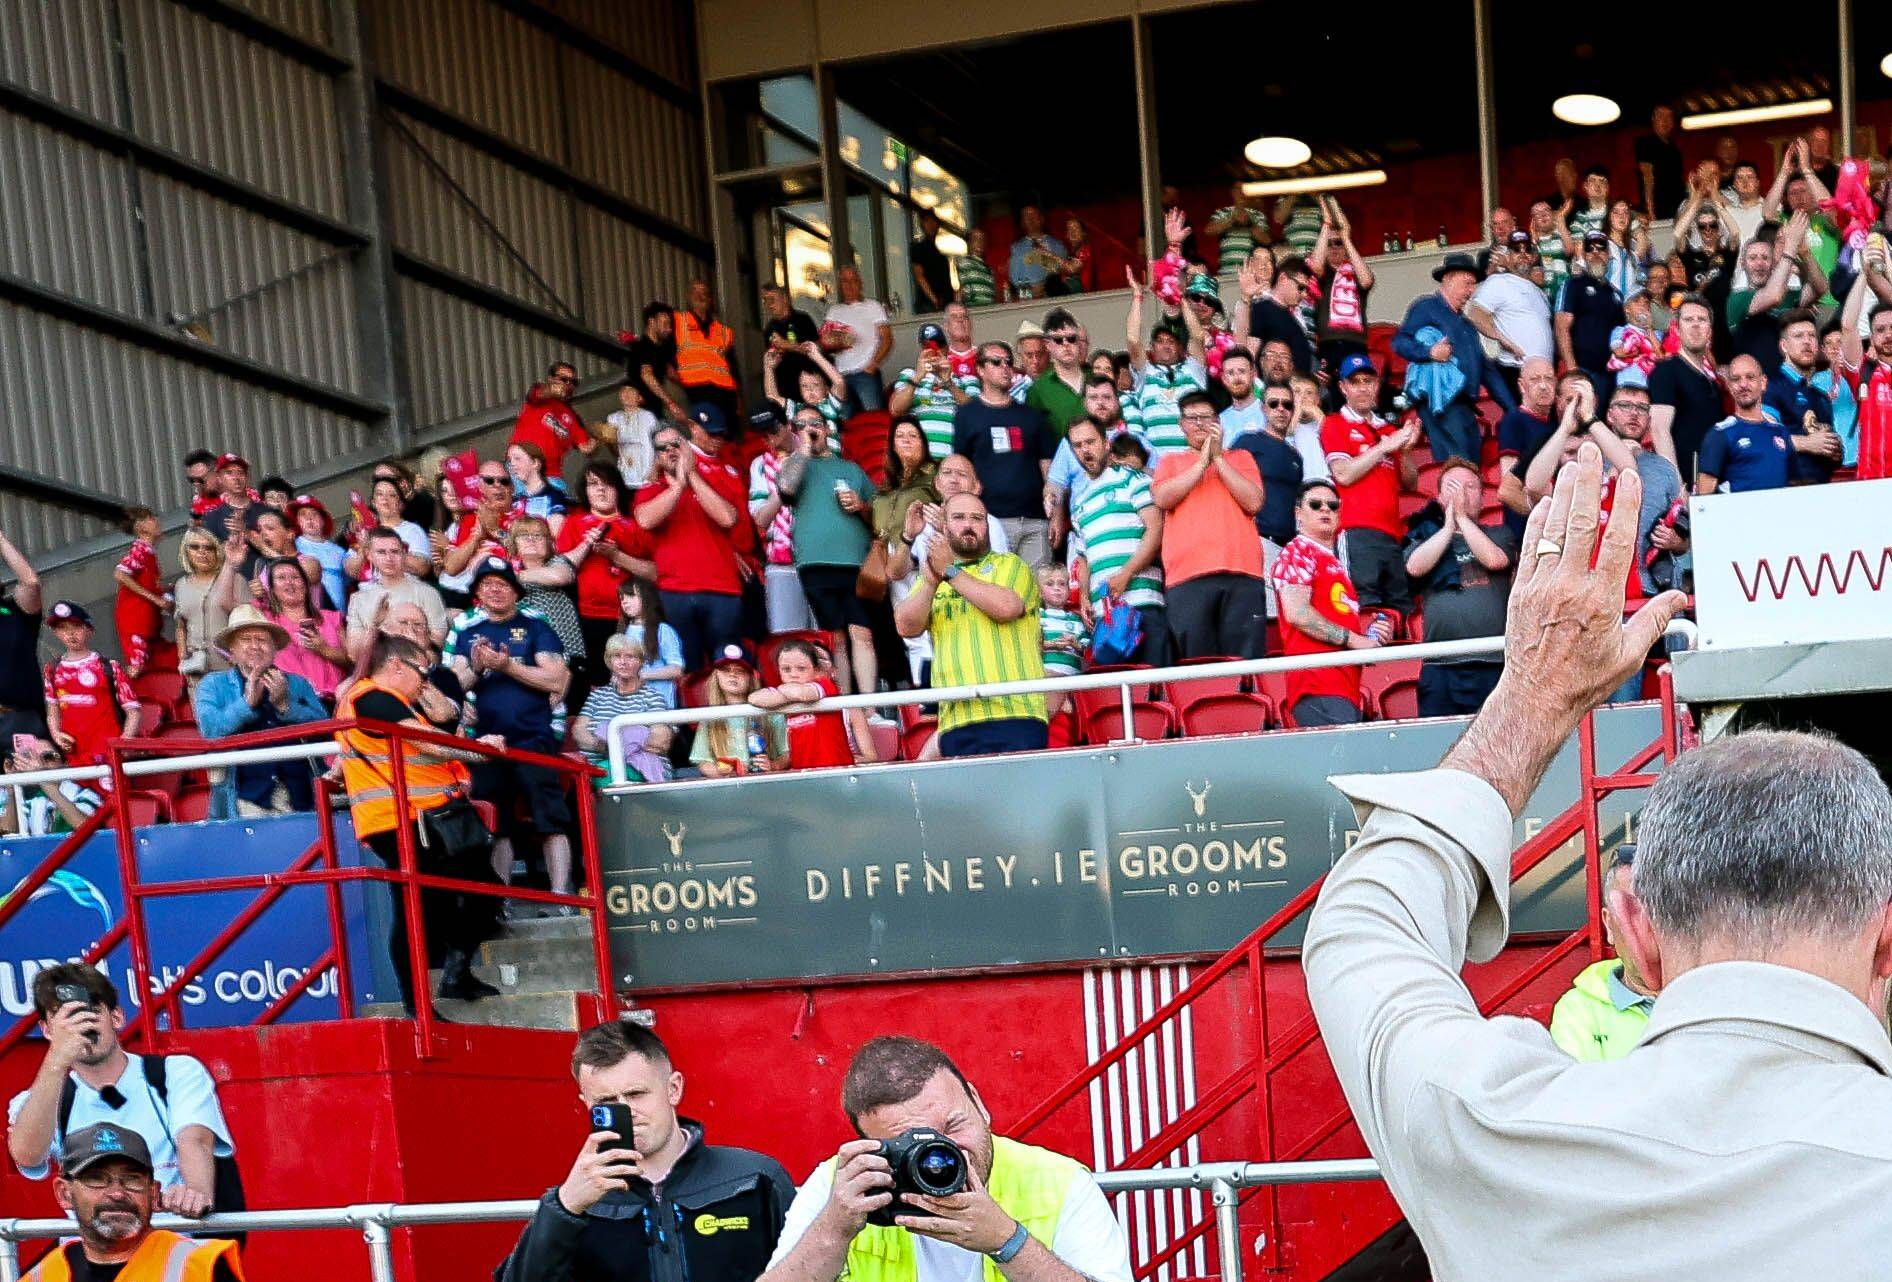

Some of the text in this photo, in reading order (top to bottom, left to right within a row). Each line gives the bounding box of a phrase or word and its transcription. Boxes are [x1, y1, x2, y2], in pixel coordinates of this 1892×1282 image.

[1184, 821, 1218, 833] THE
[1118, 836, 1288, 879] GROOM'S
[663, 861, 694, 873] THE
[806, 849, 1097, 901] DIFFNEY.IE
[606, 875, 759, 917] GROOM'S
[1168, 880, 1241, 897] ROOM
[650, 916, 717, 934] ROOM
